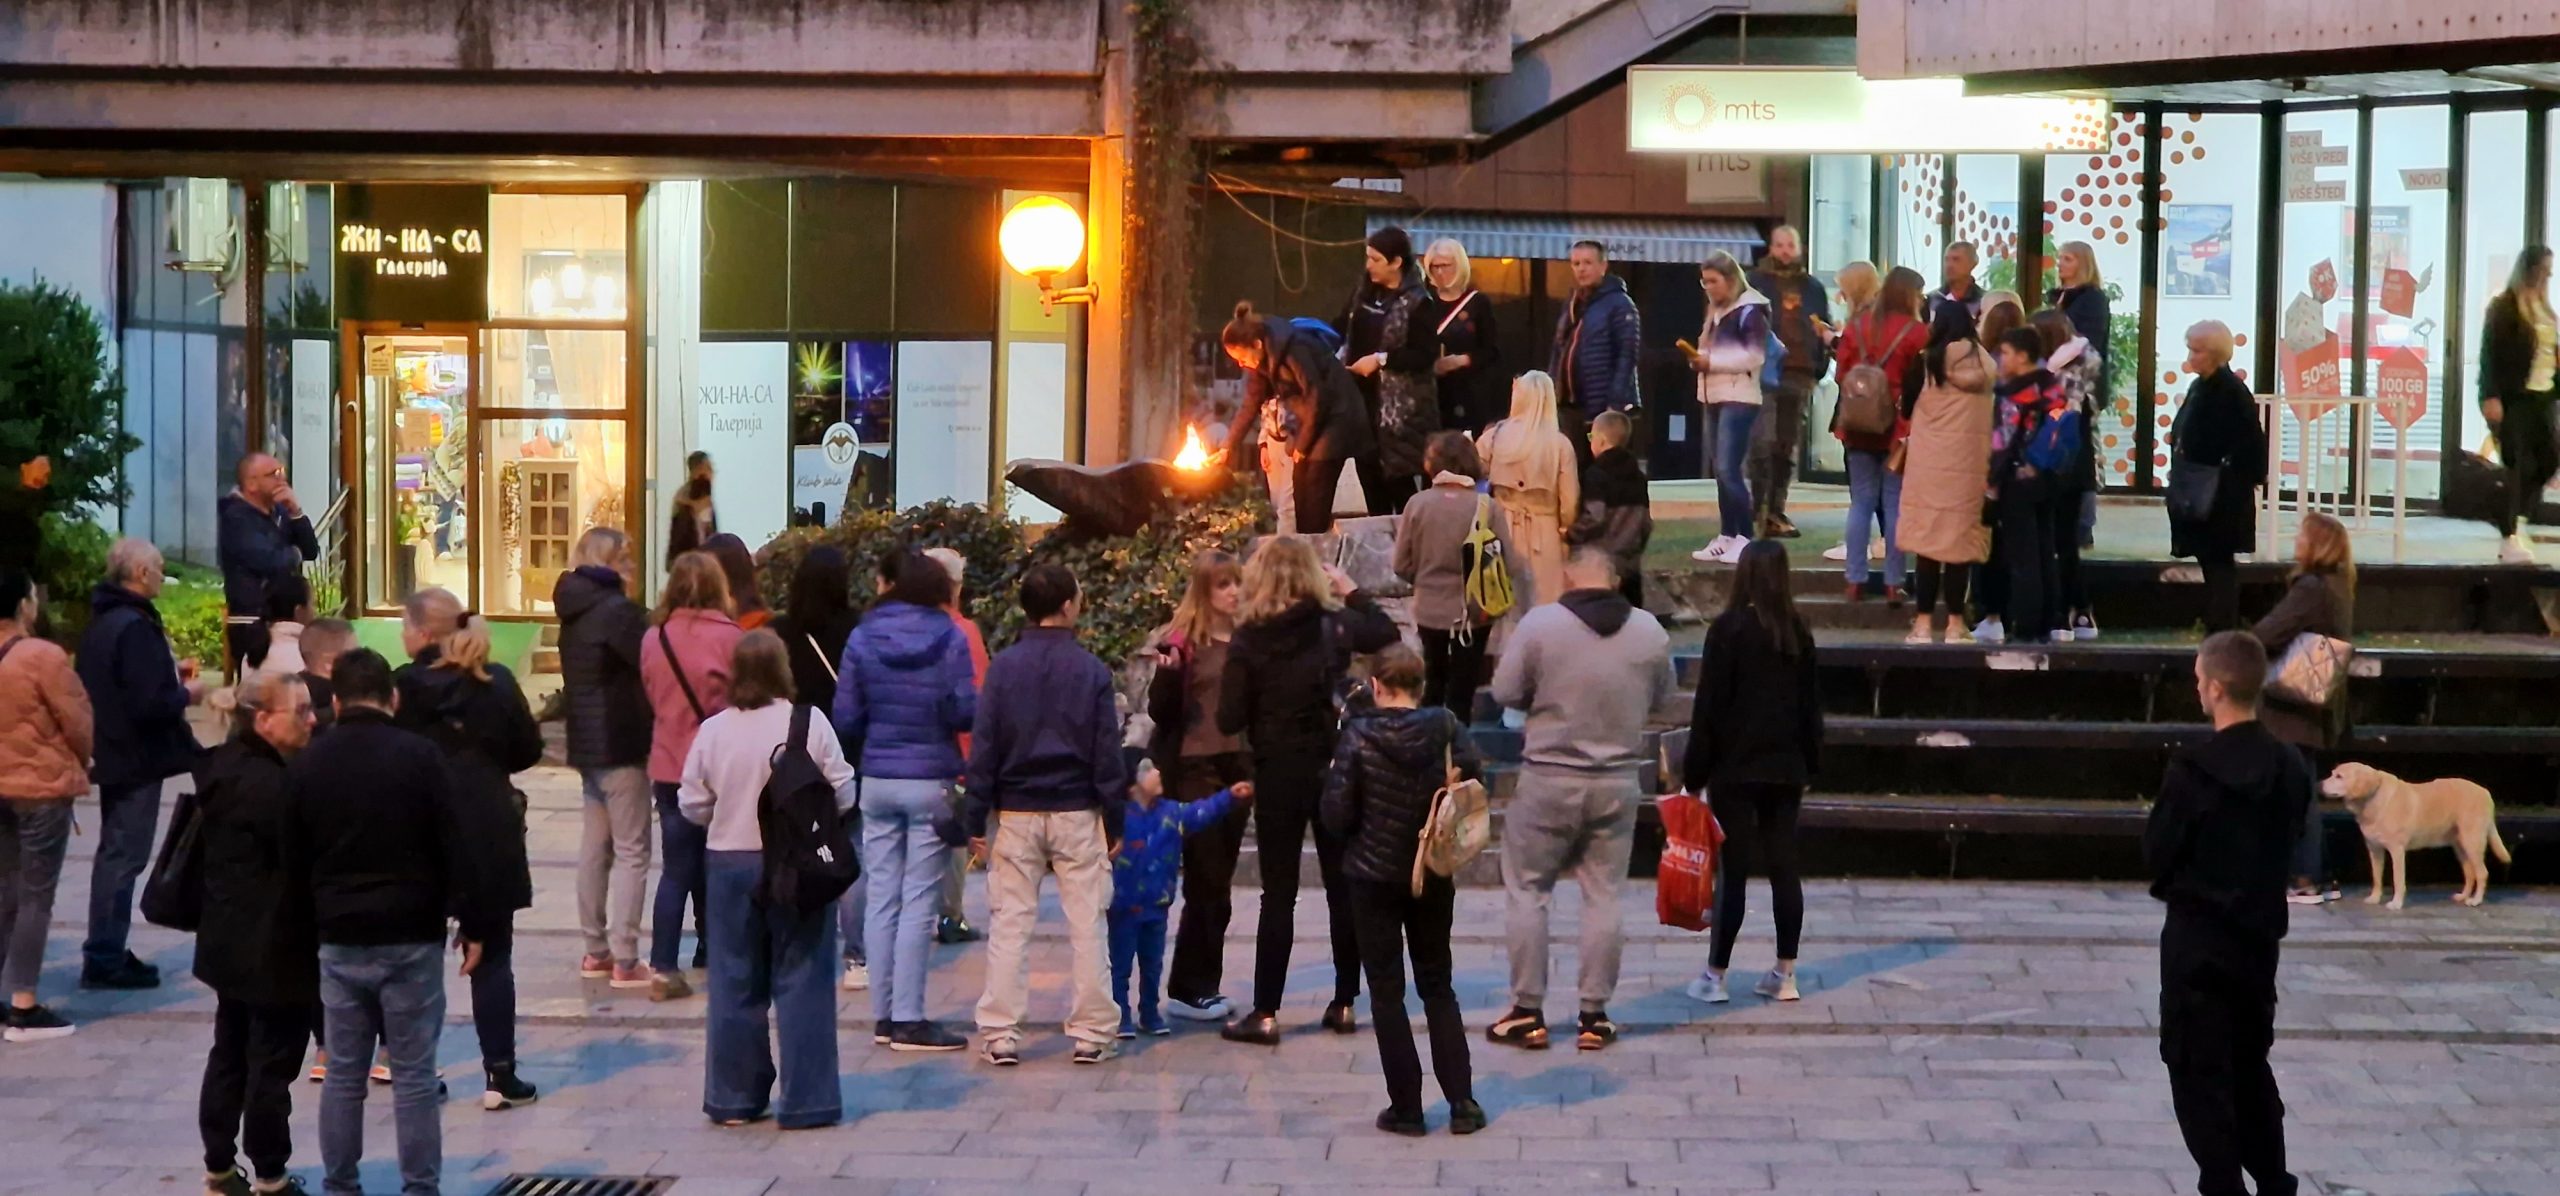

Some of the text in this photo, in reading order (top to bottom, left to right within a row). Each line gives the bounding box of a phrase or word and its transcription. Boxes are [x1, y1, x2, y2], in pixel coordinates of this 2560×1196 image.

[1725, 99, 1776, 120] mts
[2408, 173, 2442, 187] NOVO
[376, 258, 448, 278] Галерија
[2301, 359, 2337, 389] 50%
[699, 384, 774, 405] ЖИ-НА-СА
[2381, 377, 2424, 394] 100 GB
[709, 413, 763, 438] Галерија
